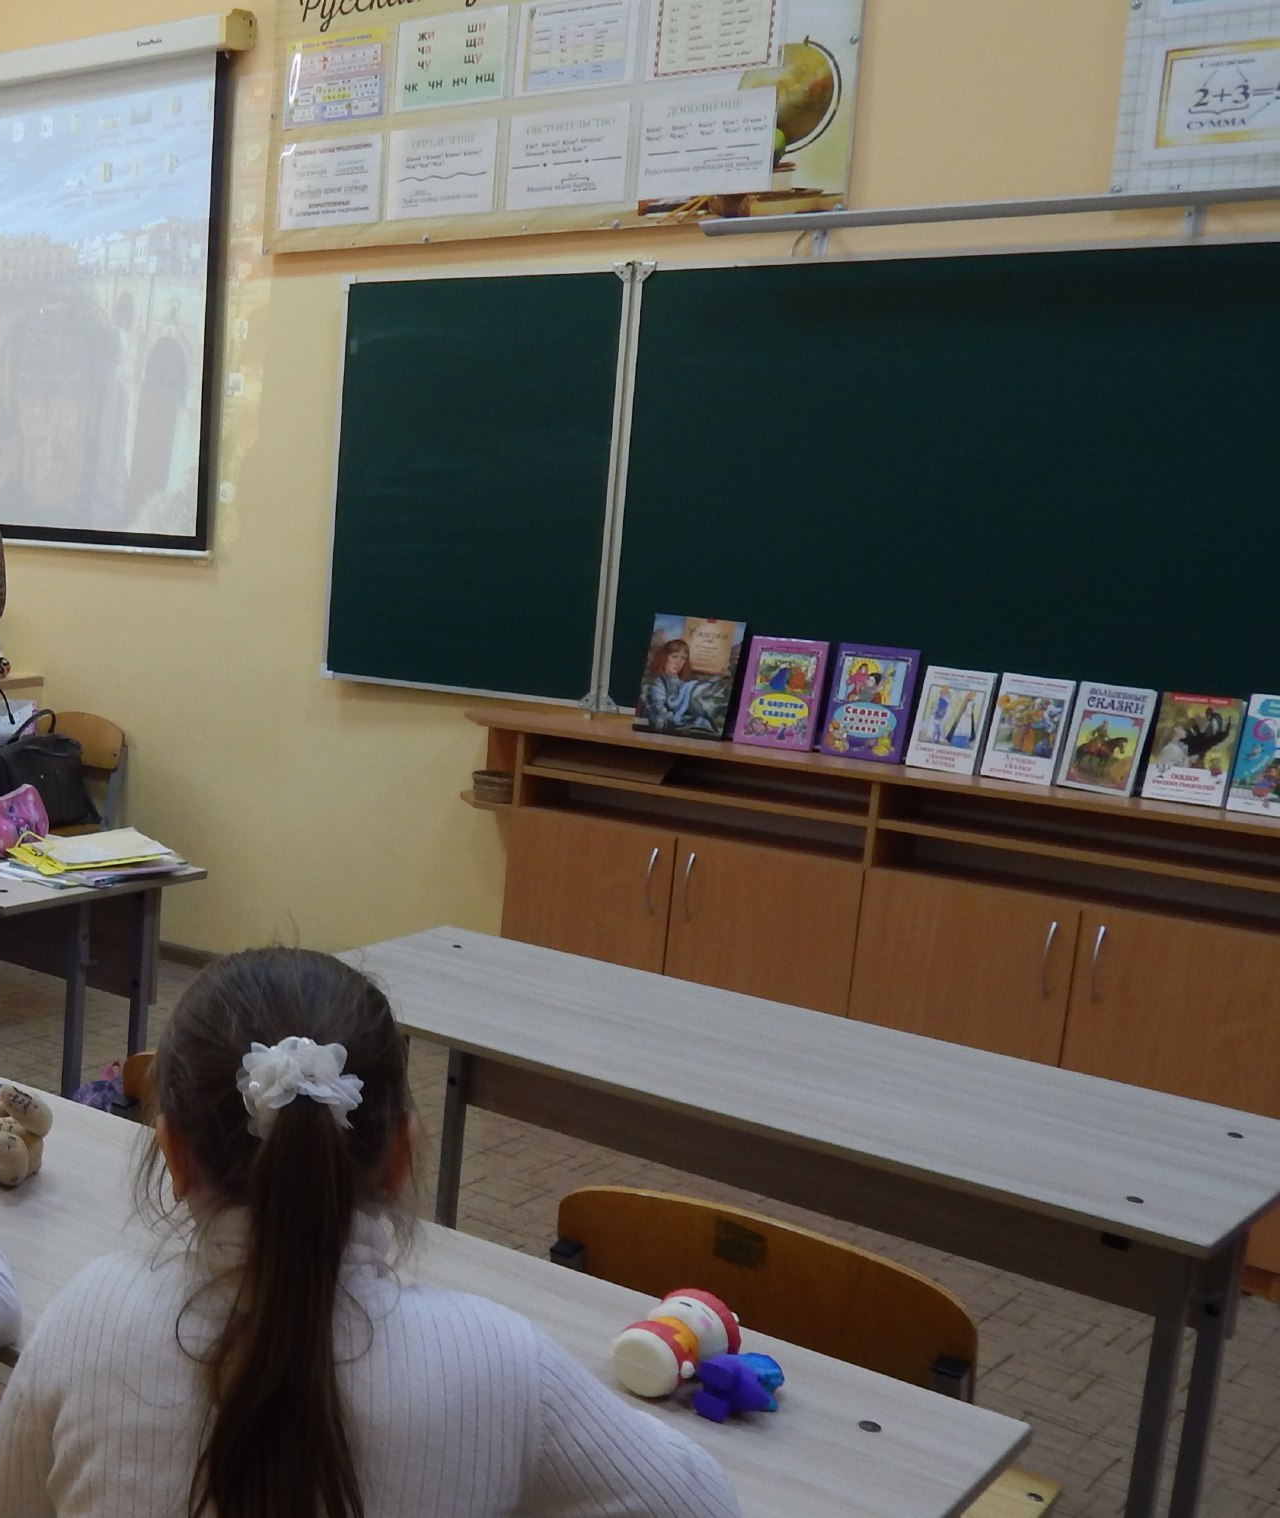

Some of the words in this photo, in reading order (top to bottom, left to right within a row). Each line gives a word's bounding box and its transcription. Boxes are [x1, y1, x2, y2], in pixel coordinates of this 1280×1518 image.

[418, 31, 435, 41] жи
[467, 22, 486, 33] ши
[418, 45, 431, 54] ча
[465, 37, 484, 48] ща
[418, 60, 431, 72] чу
[464, 53, 482, 64] щу
[404, 83, 418, 93] чк
[428, 80, 443, 89] чн
[452, 77, 467, 87] нч
[475, 73, 495, 83] нщ
[1187, 118, 1246, 130] СУММА
[767, 700, 804, 709] царстве
[1087, 696, 1145, 715] СКАЗКИ
[762, 710, 796, 718] сказок
[845, 706, 888, 718] Сказки
[858, 717, 886, 725] всего
